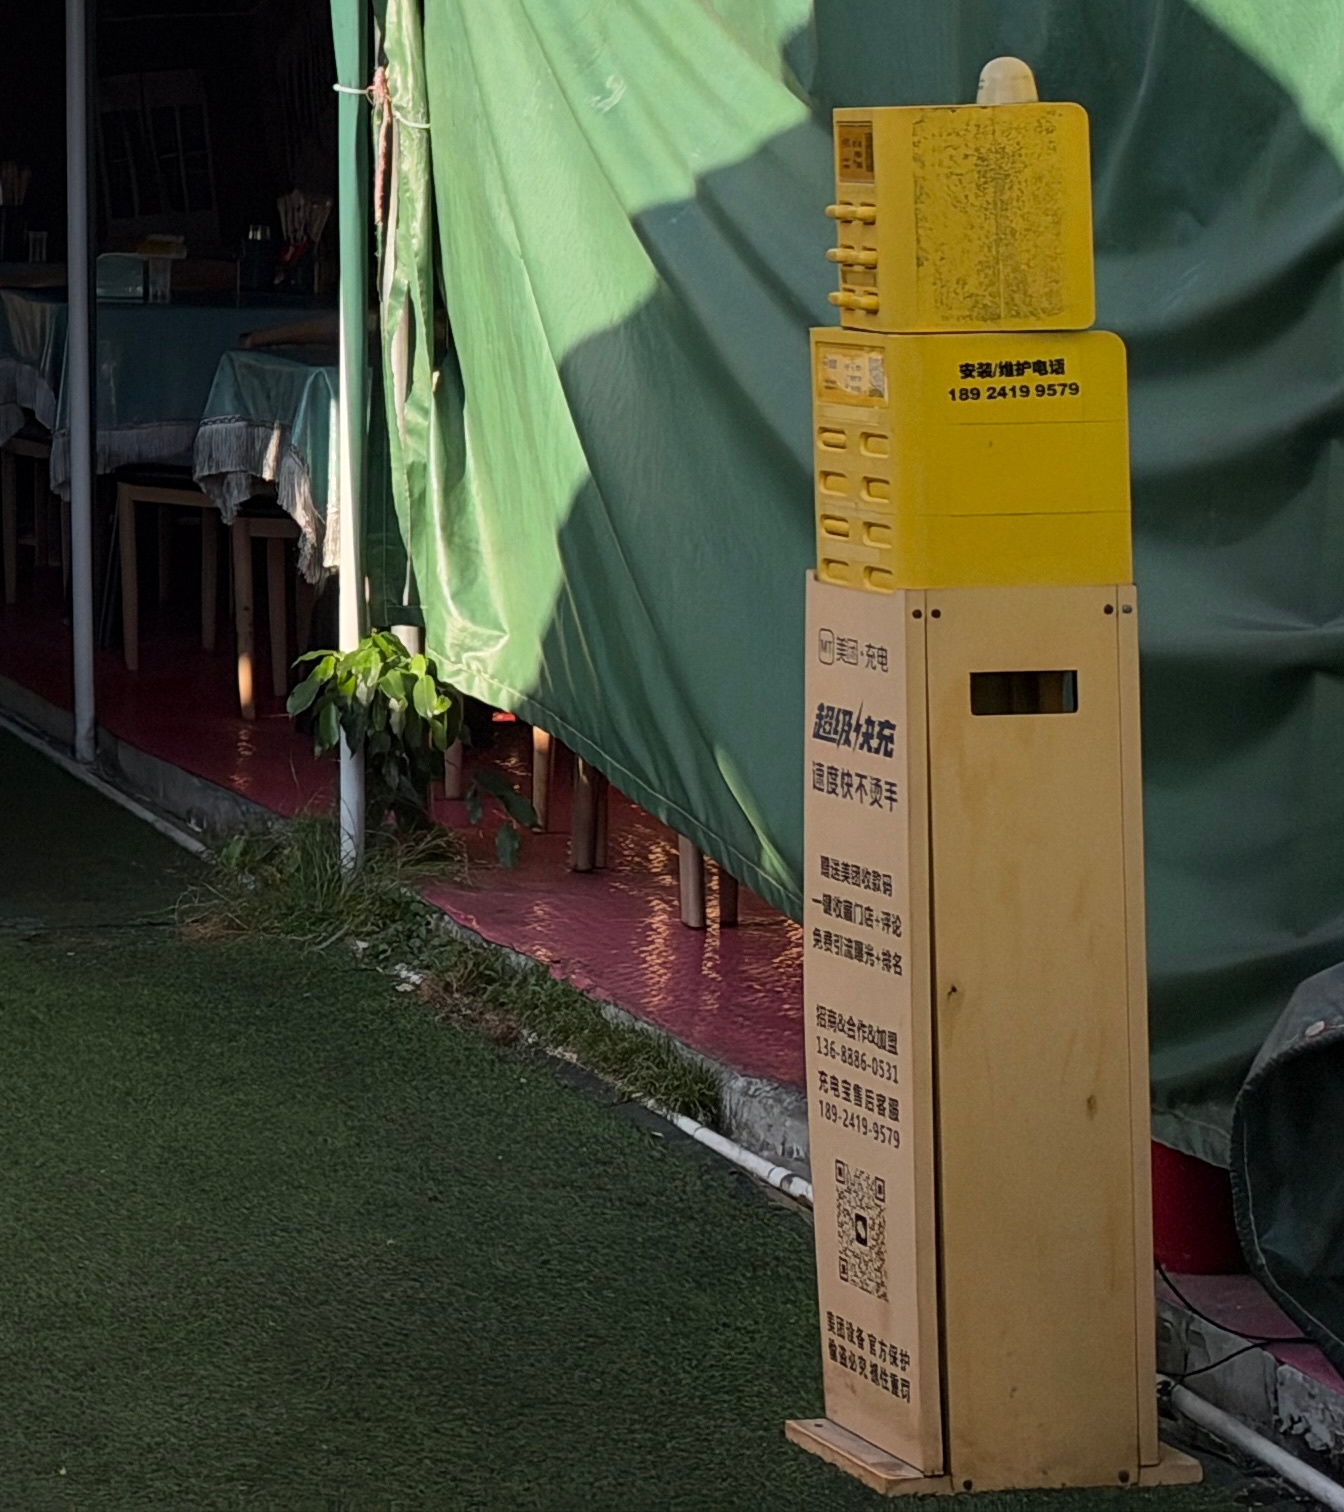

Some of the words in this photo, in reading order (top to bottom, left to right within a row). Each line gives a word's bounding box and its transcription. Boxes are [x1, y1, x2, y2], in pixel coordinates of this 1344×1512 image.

[949, 387, 981, 401] 189
[986, 385, 1030, 400] 2419
[1035, 382, 1080, 397] 9579
[959, 358, 1065, 379] 安装/维护电话
[812, 701, 897, 759] 超级快充
[812, 760, 898, 812] 速度快不烫手
[815, 1004, 899, 1056] 招商&合作&加盟
[817, 1070, 900, 1123] 充电宝售后客服
[818, 1099, 901, 1149] 189-2419-9579
[827, 1310, 865, 1351] 美团设备
[867, 1332, 911, 1373] 官方保护
